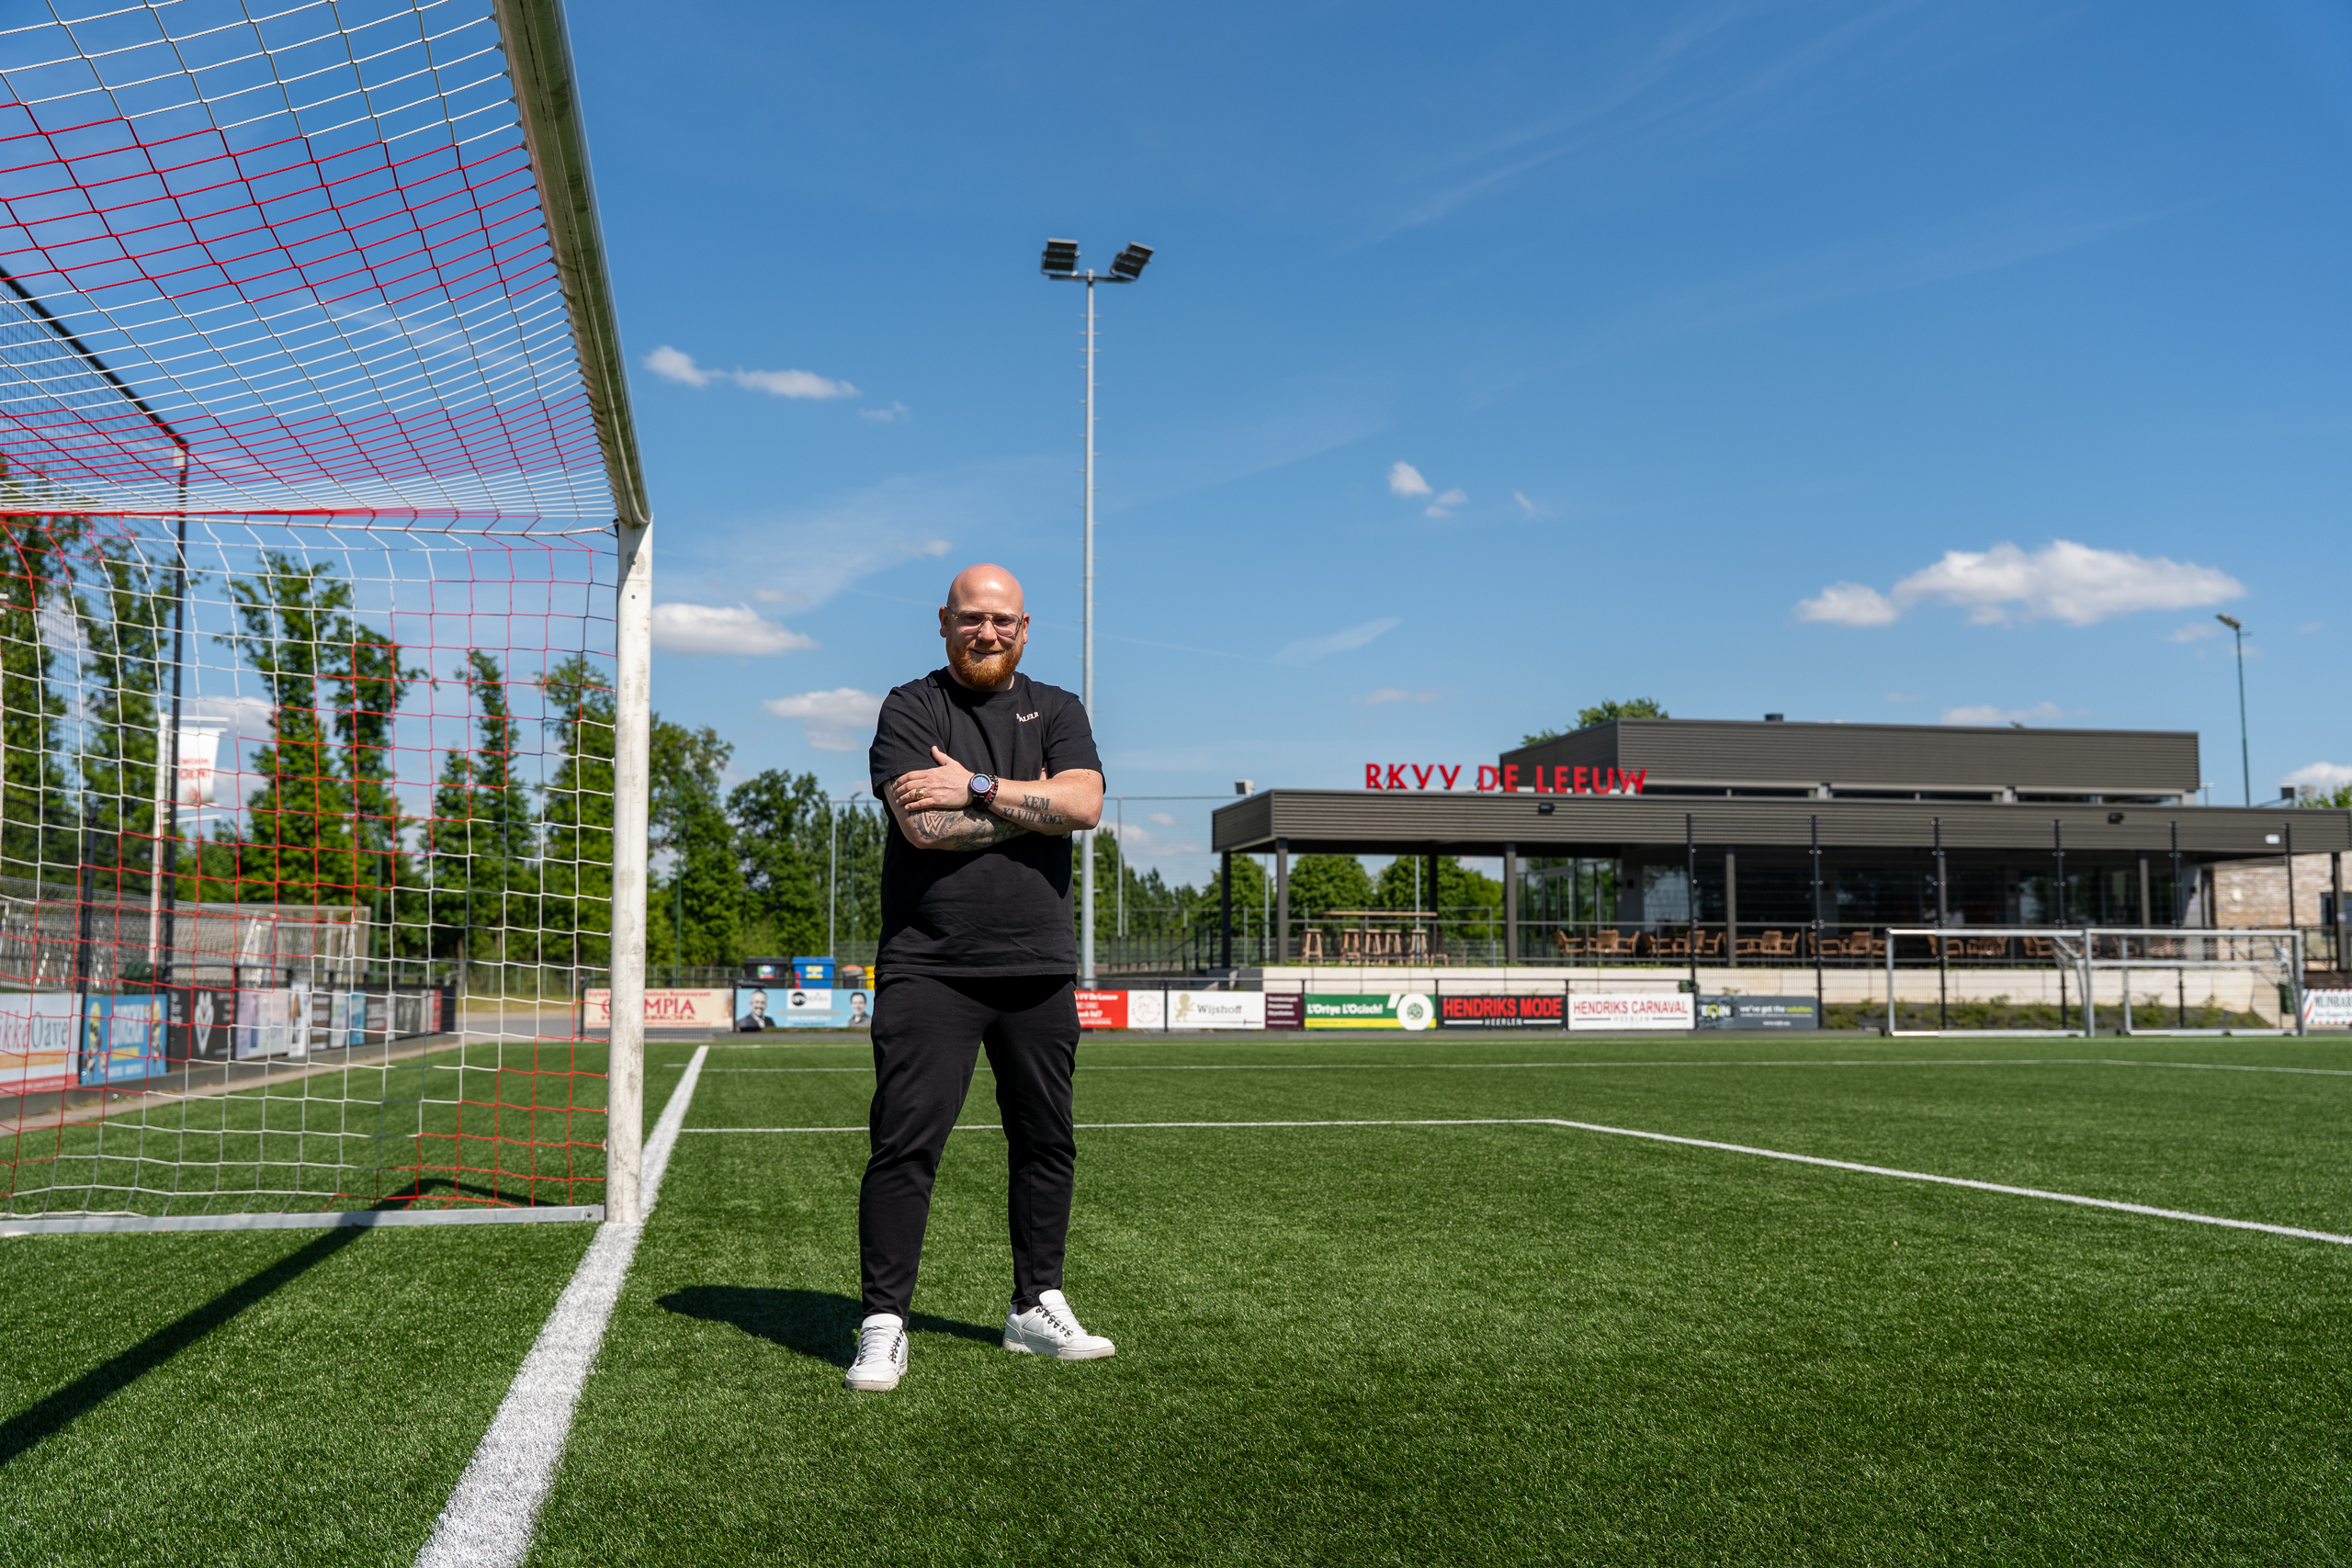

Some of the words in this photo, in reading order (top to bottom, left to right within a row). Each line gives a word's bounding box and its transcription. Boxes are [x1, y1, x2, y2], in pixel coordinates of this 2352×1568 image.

[1365, 763, 1462, 790] RKVV
[1477, 764, 1519, 792] DE
[1535, 765, 1646, 795] LEEUW
[1021, 795, 1050, 810] XEM
[1001, 807, 1015, 818] XI
[1197, 1005, 1242, 1015] Wijshoff
[1443, 998, 1517, 1017] HENDRIKS
[1520, 998, 1562, 1017] MODE
[1573, 1000, 1628, 1014] HENDRIKS
[1631, 1000, 1688, 1014] CARNAVAL
[1484, 1018, 1522, 1026] HEERLEN
